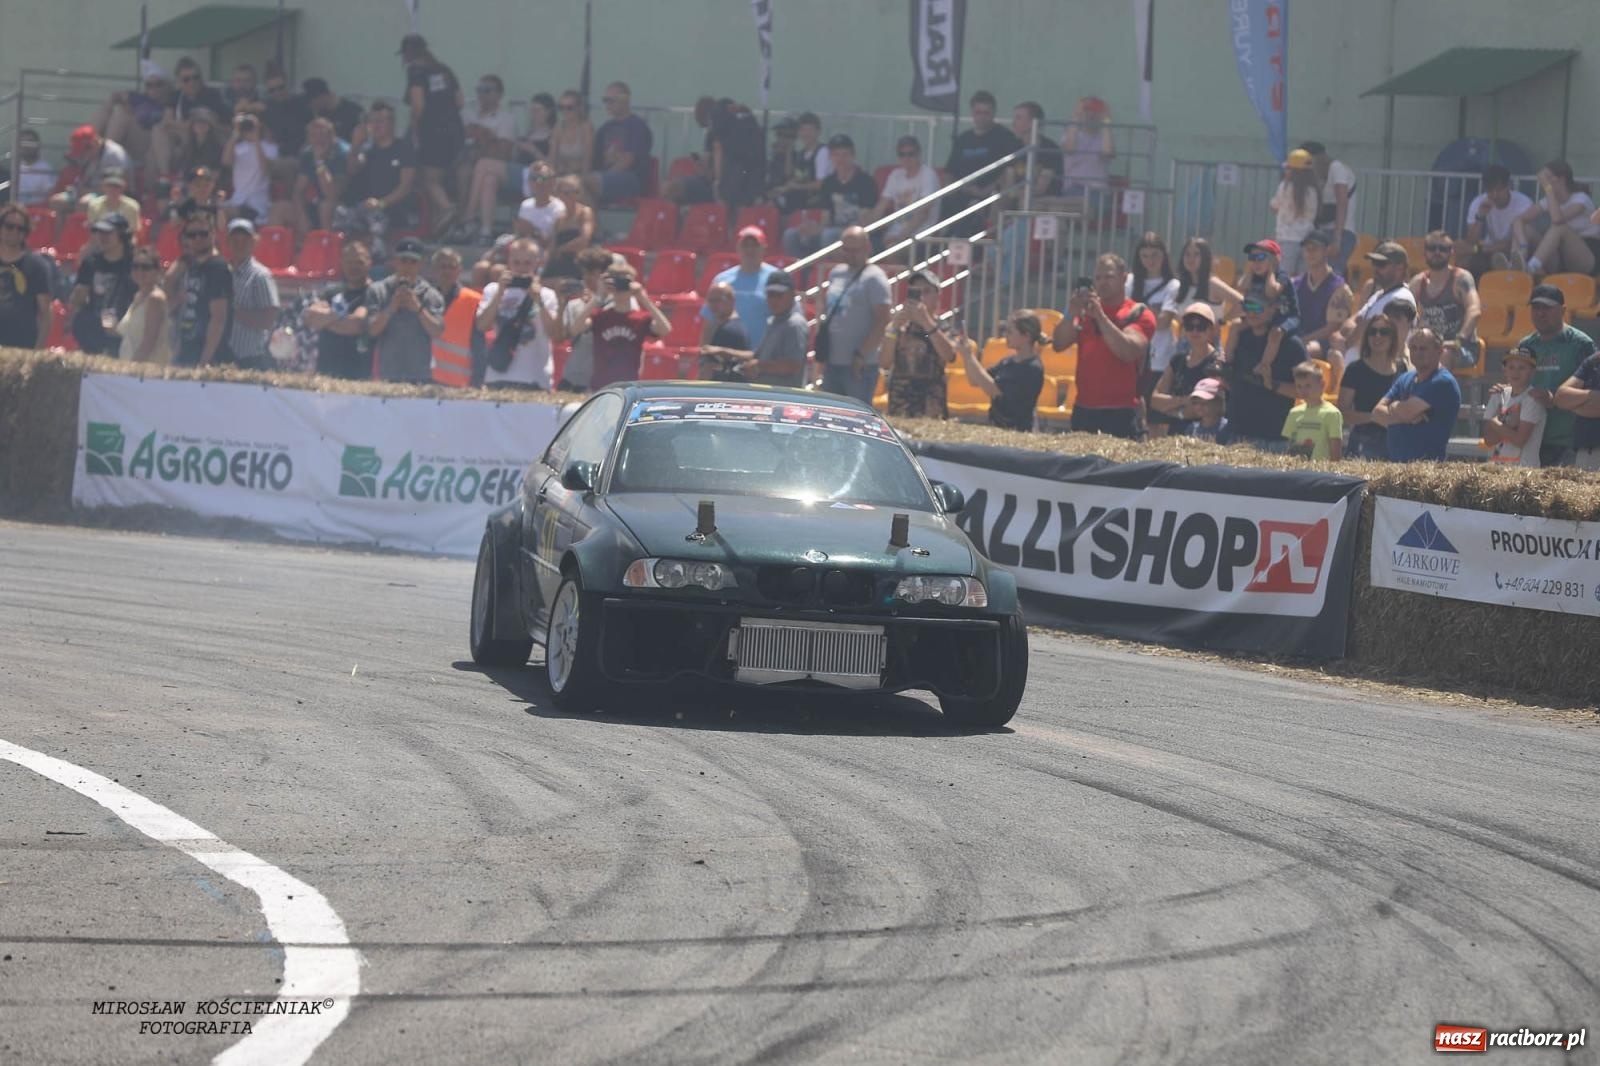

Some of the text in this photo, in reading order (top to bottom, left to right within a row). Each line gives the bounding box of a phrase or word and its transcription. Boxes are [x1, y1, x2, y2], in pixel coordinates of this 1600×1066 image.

[129, 429, 292, 491] AGROEKO
[382, 451, 525, 505] AGROEK
[956, 488, 1259, 592] ALLYSHOP
[1392, 551, 1460, 575] MARKOWE
[1542, 579, 1562, 595] 229
[1564, 582, 1585, 599] 831
